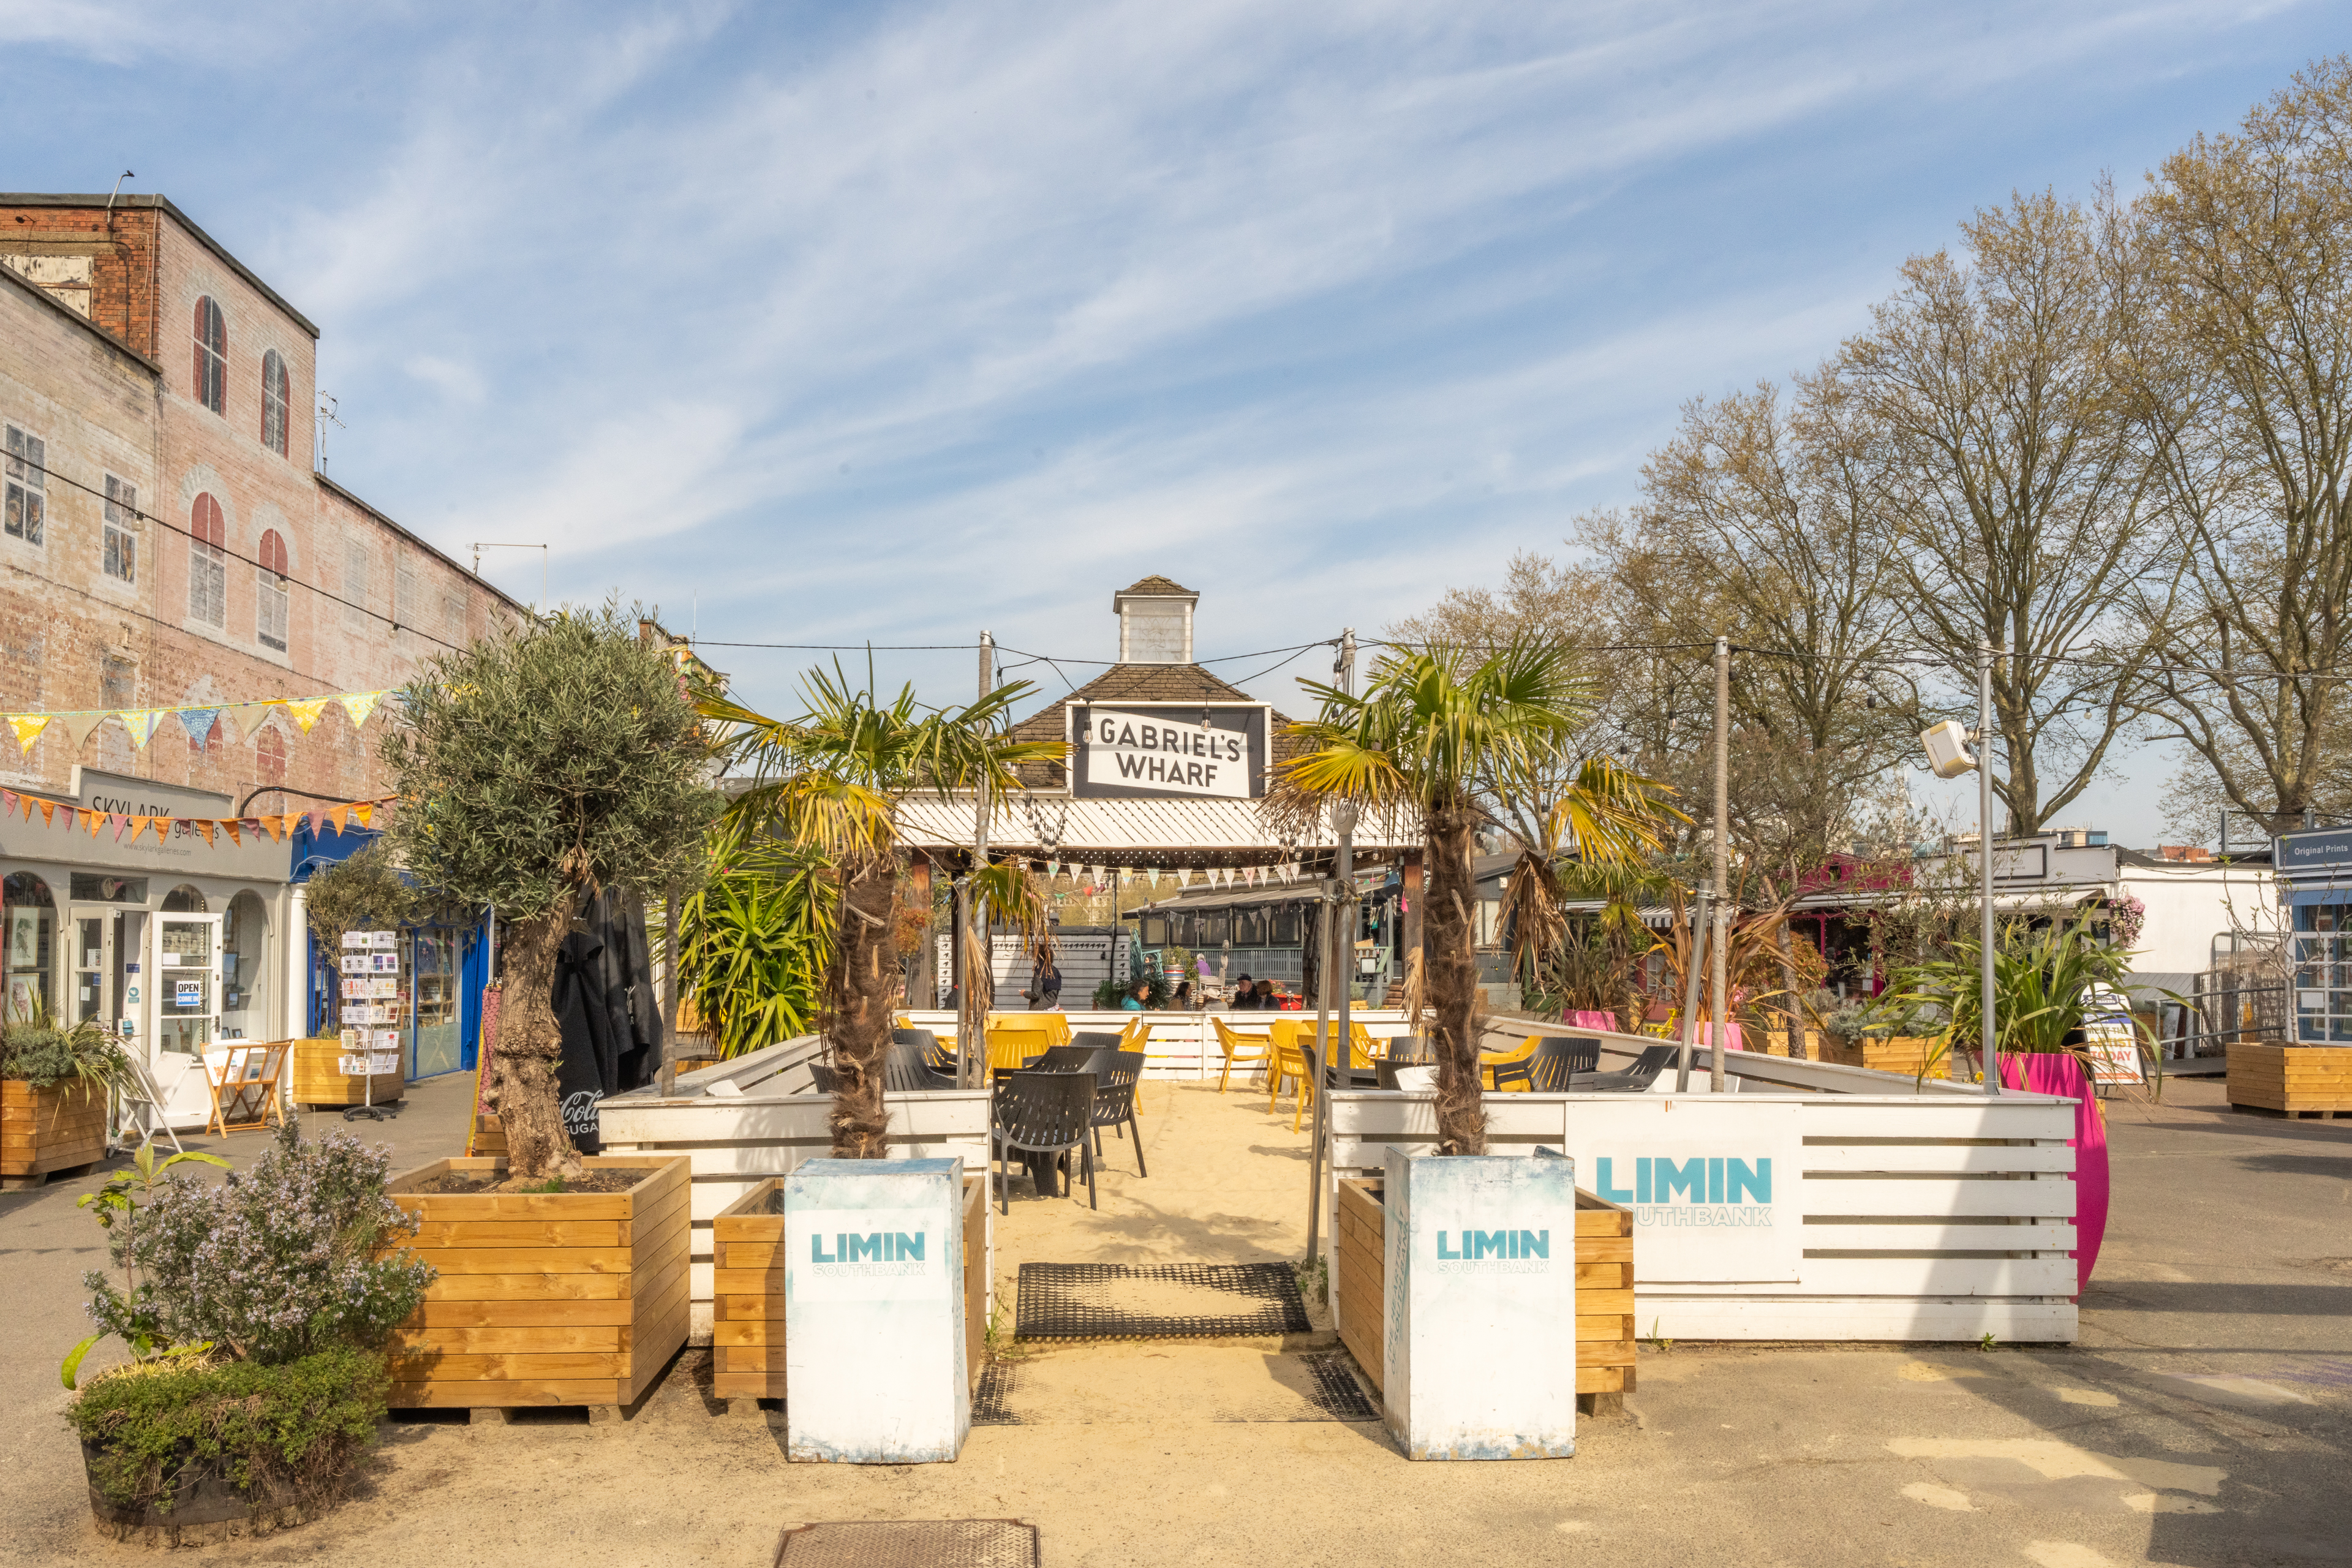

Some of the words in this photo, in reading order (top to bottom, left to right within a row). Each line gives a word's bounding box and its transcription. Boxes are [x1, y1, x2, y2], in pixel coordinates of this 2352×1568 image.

[1100, 718, 1240, 762] GABRIEL'S
[1115, 752, 1218, 787] WHARF
[123, 842, 191, 856] www.skylarkgalleries.com
[2294, 846, 2323, 856] Original
[178, 984, 199, 992] OPEN
[1596, 1157, 1772, 1204] LIMIN
[1621, 1207, 1772, 1226] UTHBANK
[812, 1232, 925, 1263] LIMIN
[1437, 1230, 1550, 1259] LIMIN
[812, 1262, 926, 1278] SOUTHBANK
[1390, 1205, 1404, 1324] HEARTBEAT
[1438, 1261, 1550, 1275] SOUTHBANK
[1391, 1345, 1396, 1376] OF
[1394, 1276, 1403, 1346] SOUTH
[1400, 1216, 1408, 1276] BANK
